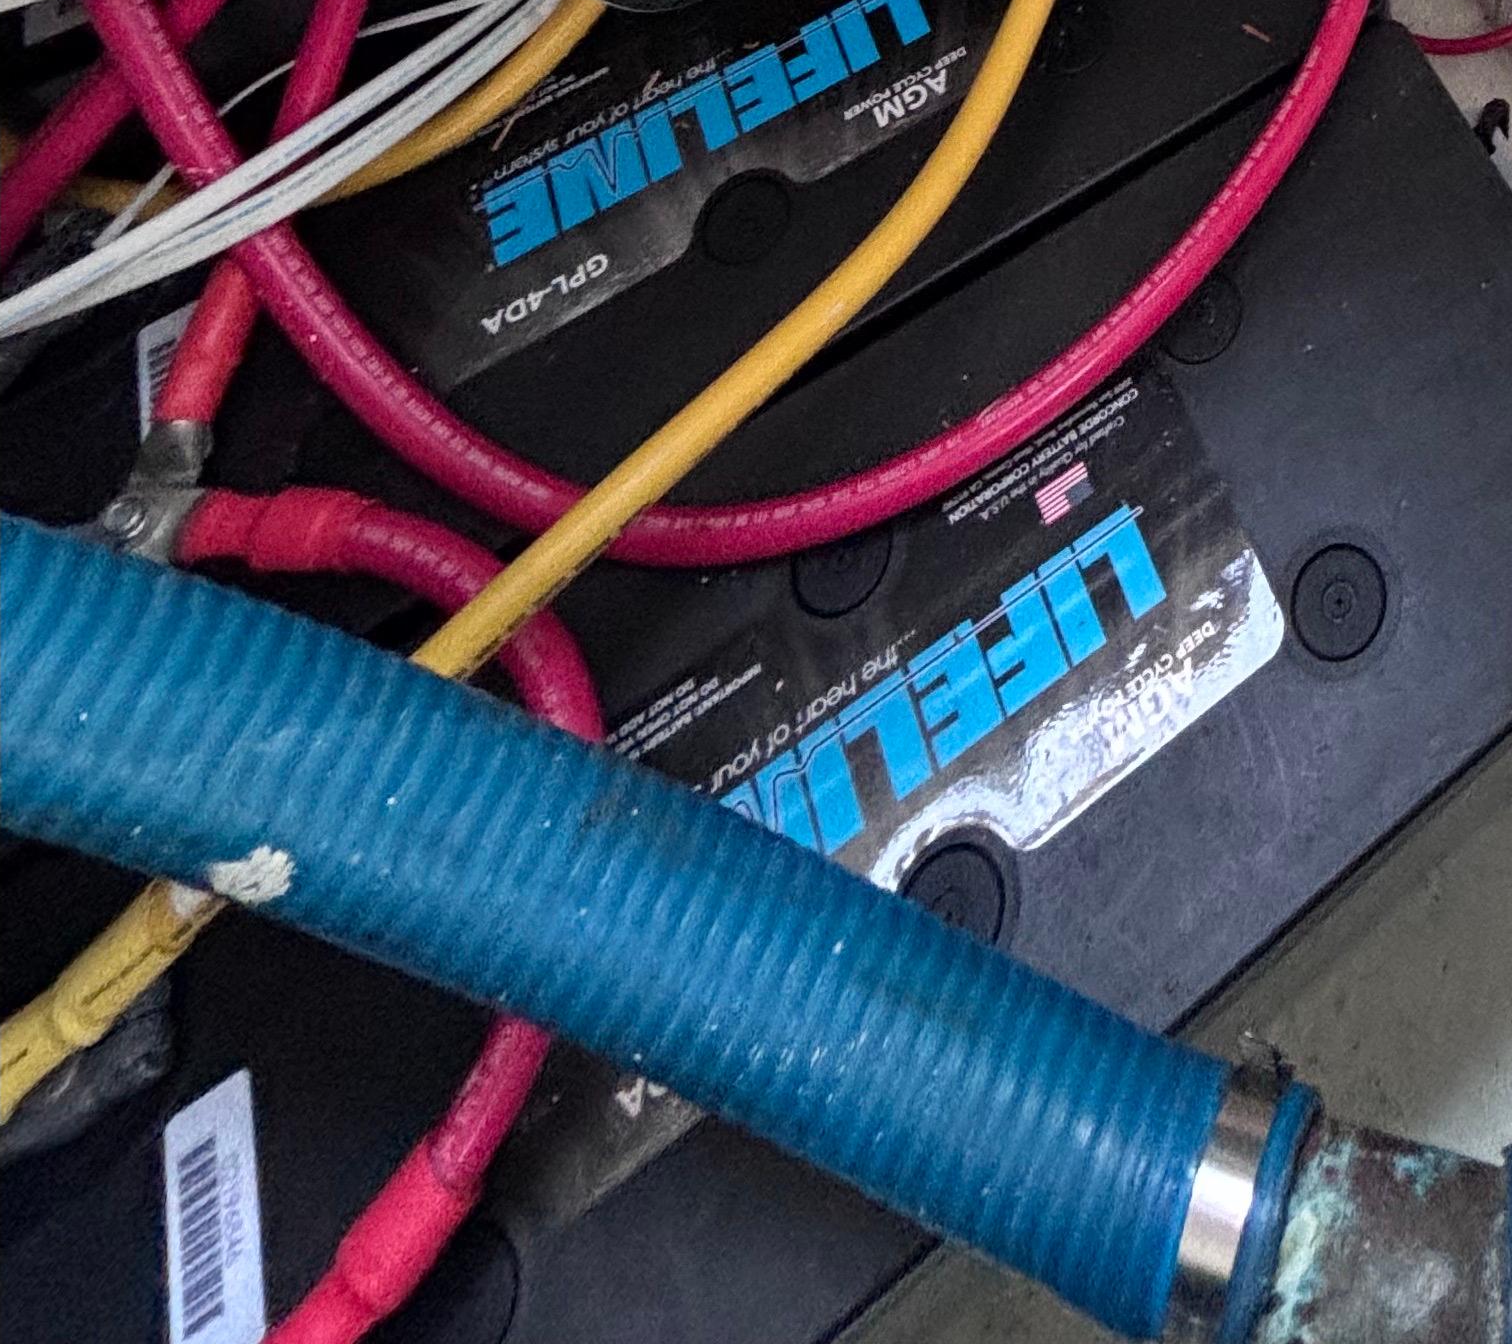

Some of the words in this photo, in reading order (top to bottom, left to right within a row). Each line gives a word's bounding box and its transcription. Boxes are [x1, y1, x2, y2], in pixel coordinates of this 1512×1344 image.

[890, 64, 933, 93] CYCLE
[932, 46, 967, 70] DEEP
[604, 100, 631, 125] of
[840, 87, 892, 121] POWER
[869, 68, 955, 128] AGM
[559, 109, 611, 148] your
[481, 252, 609, 336] GPL-4DA
[1074, 385, 1140, 436] CONCORDE
[1028, 428, 1078, 468] BATTERY
[945, 460, 1031, 525] CORPORATION
[1170, 619, 1218, 660] DEEP
[1122, 650, 1178, 698] CYCLE
[784, 672, 865, 736] heart
[756, 721, 797, 758] of
[699, 736, 770, 794] your
